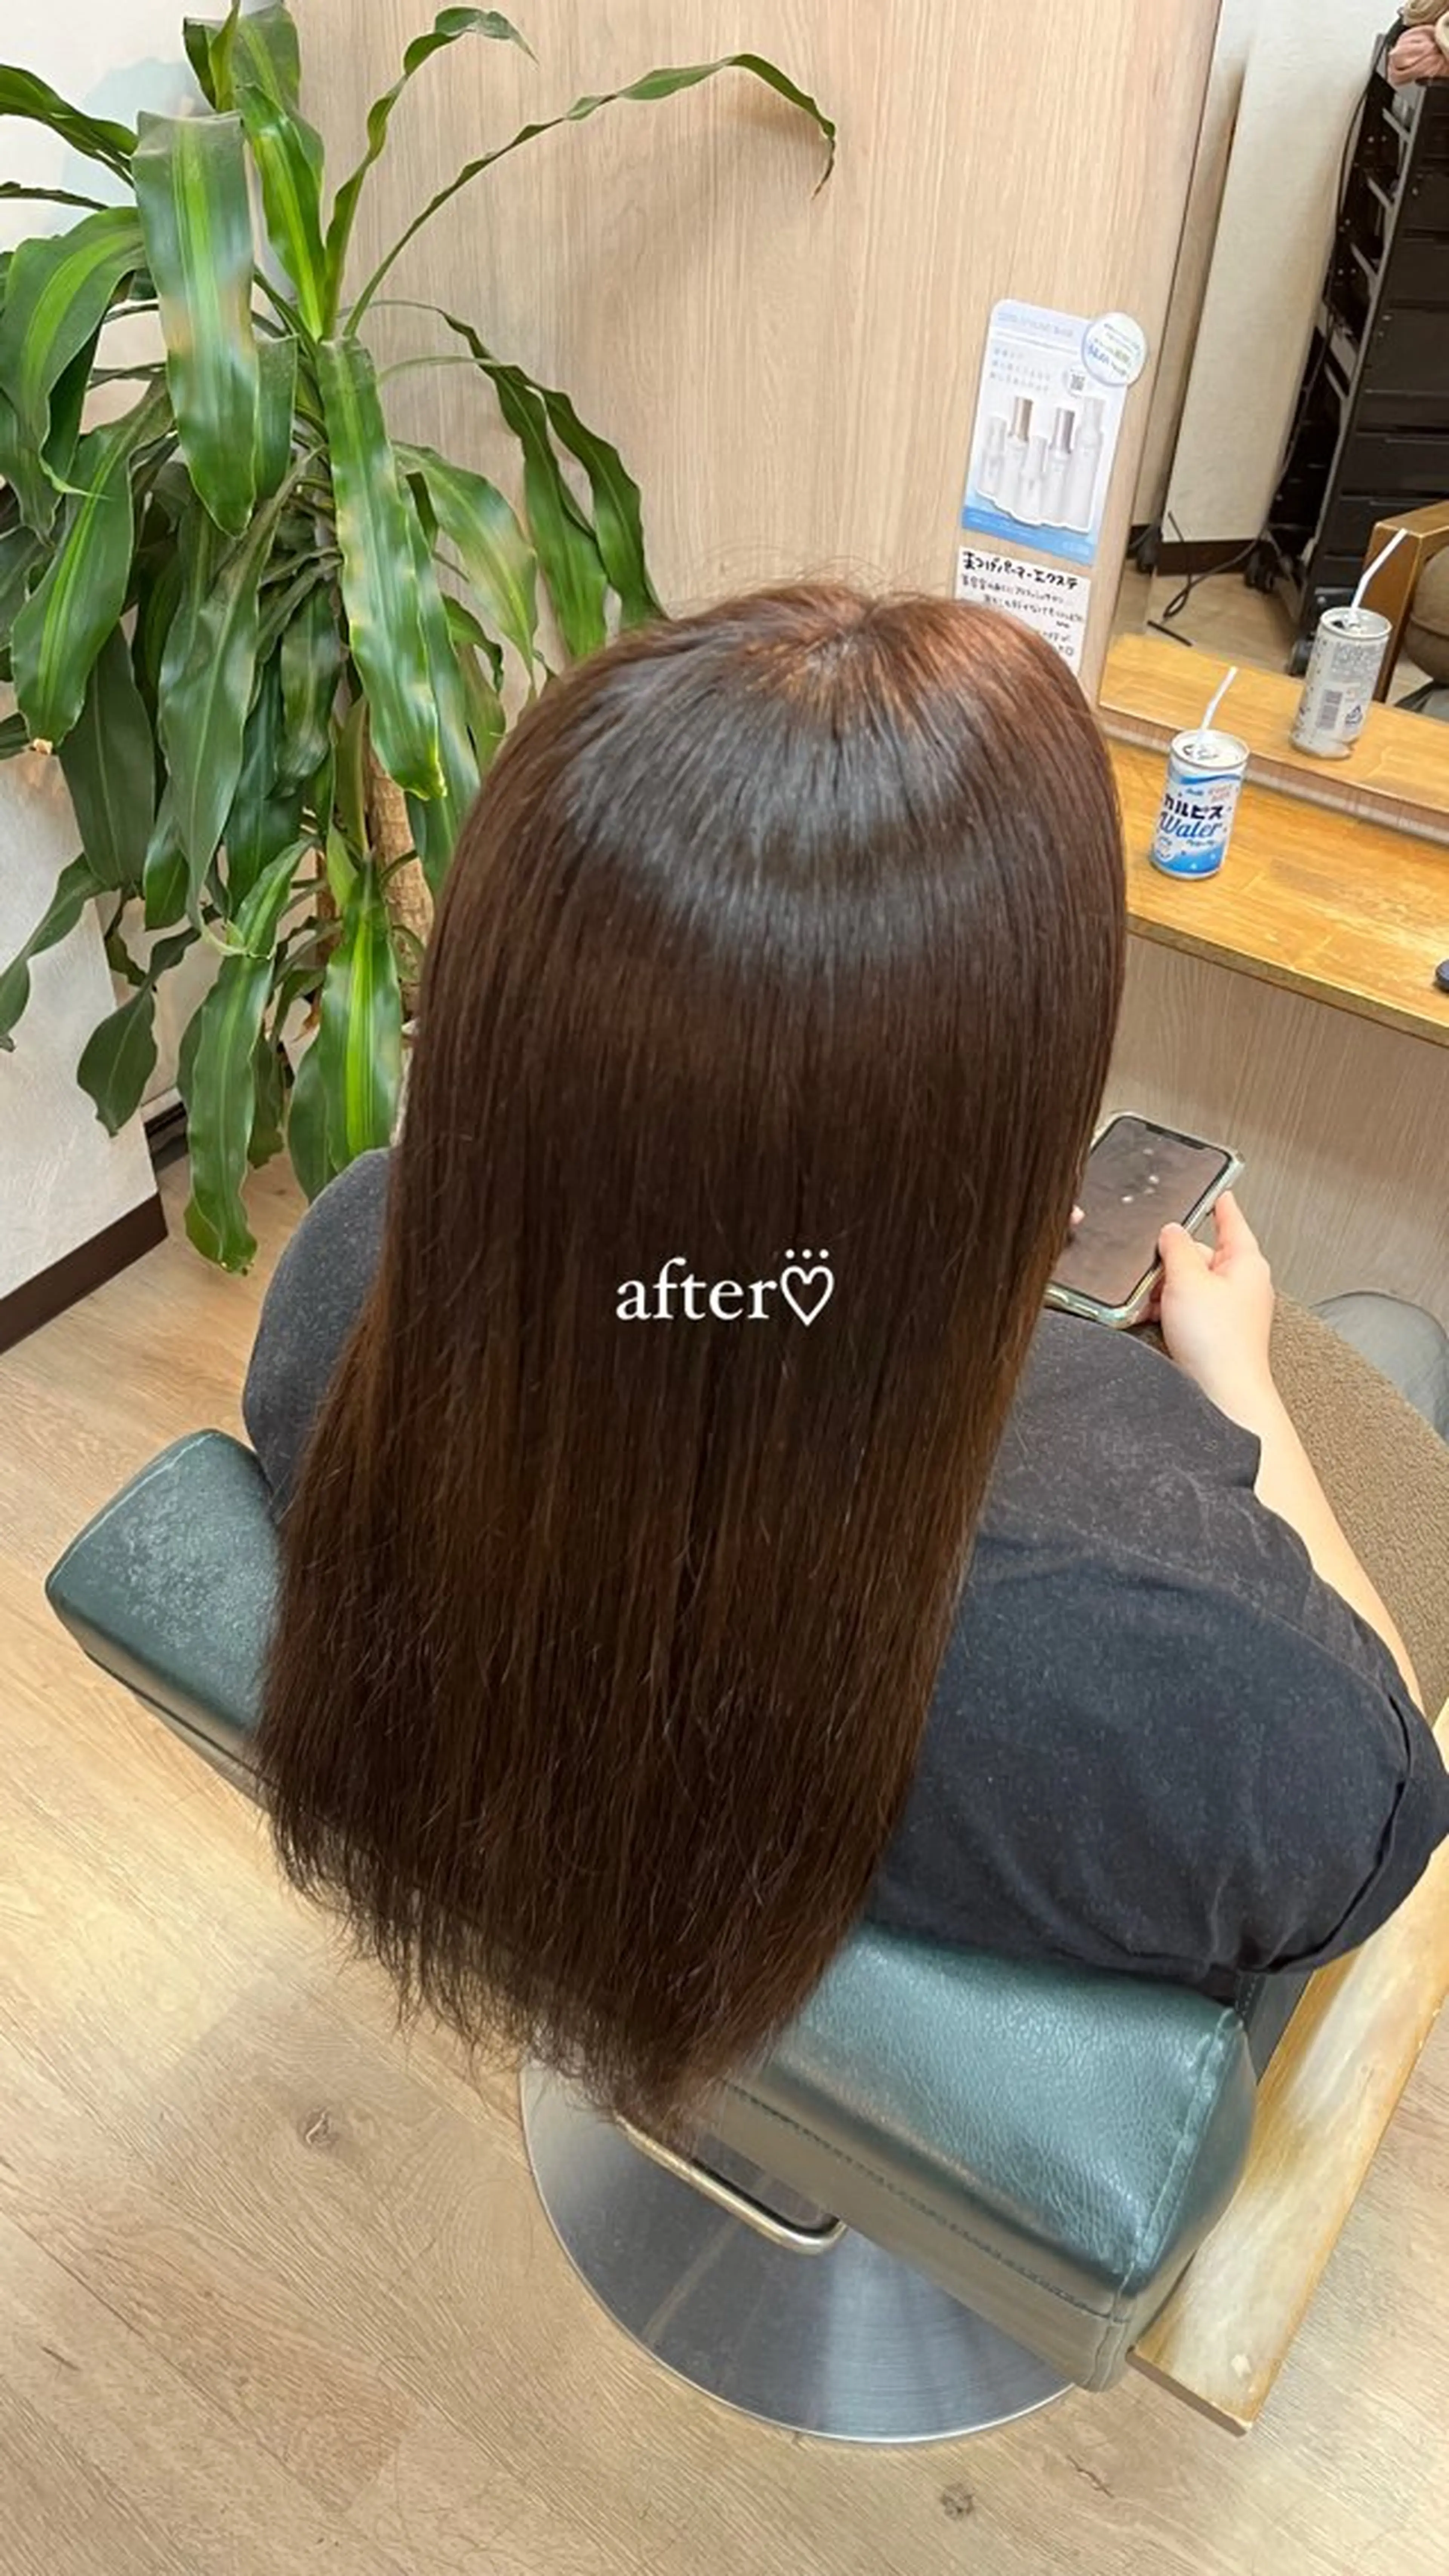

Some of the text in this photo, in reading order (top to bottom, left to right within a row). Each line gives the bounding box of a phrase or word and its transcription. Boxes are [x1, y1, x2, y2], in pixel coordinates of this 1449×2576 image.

[1164, 793, 1223, 820] カルピス
[1160, 812, 1223, 838] Water
